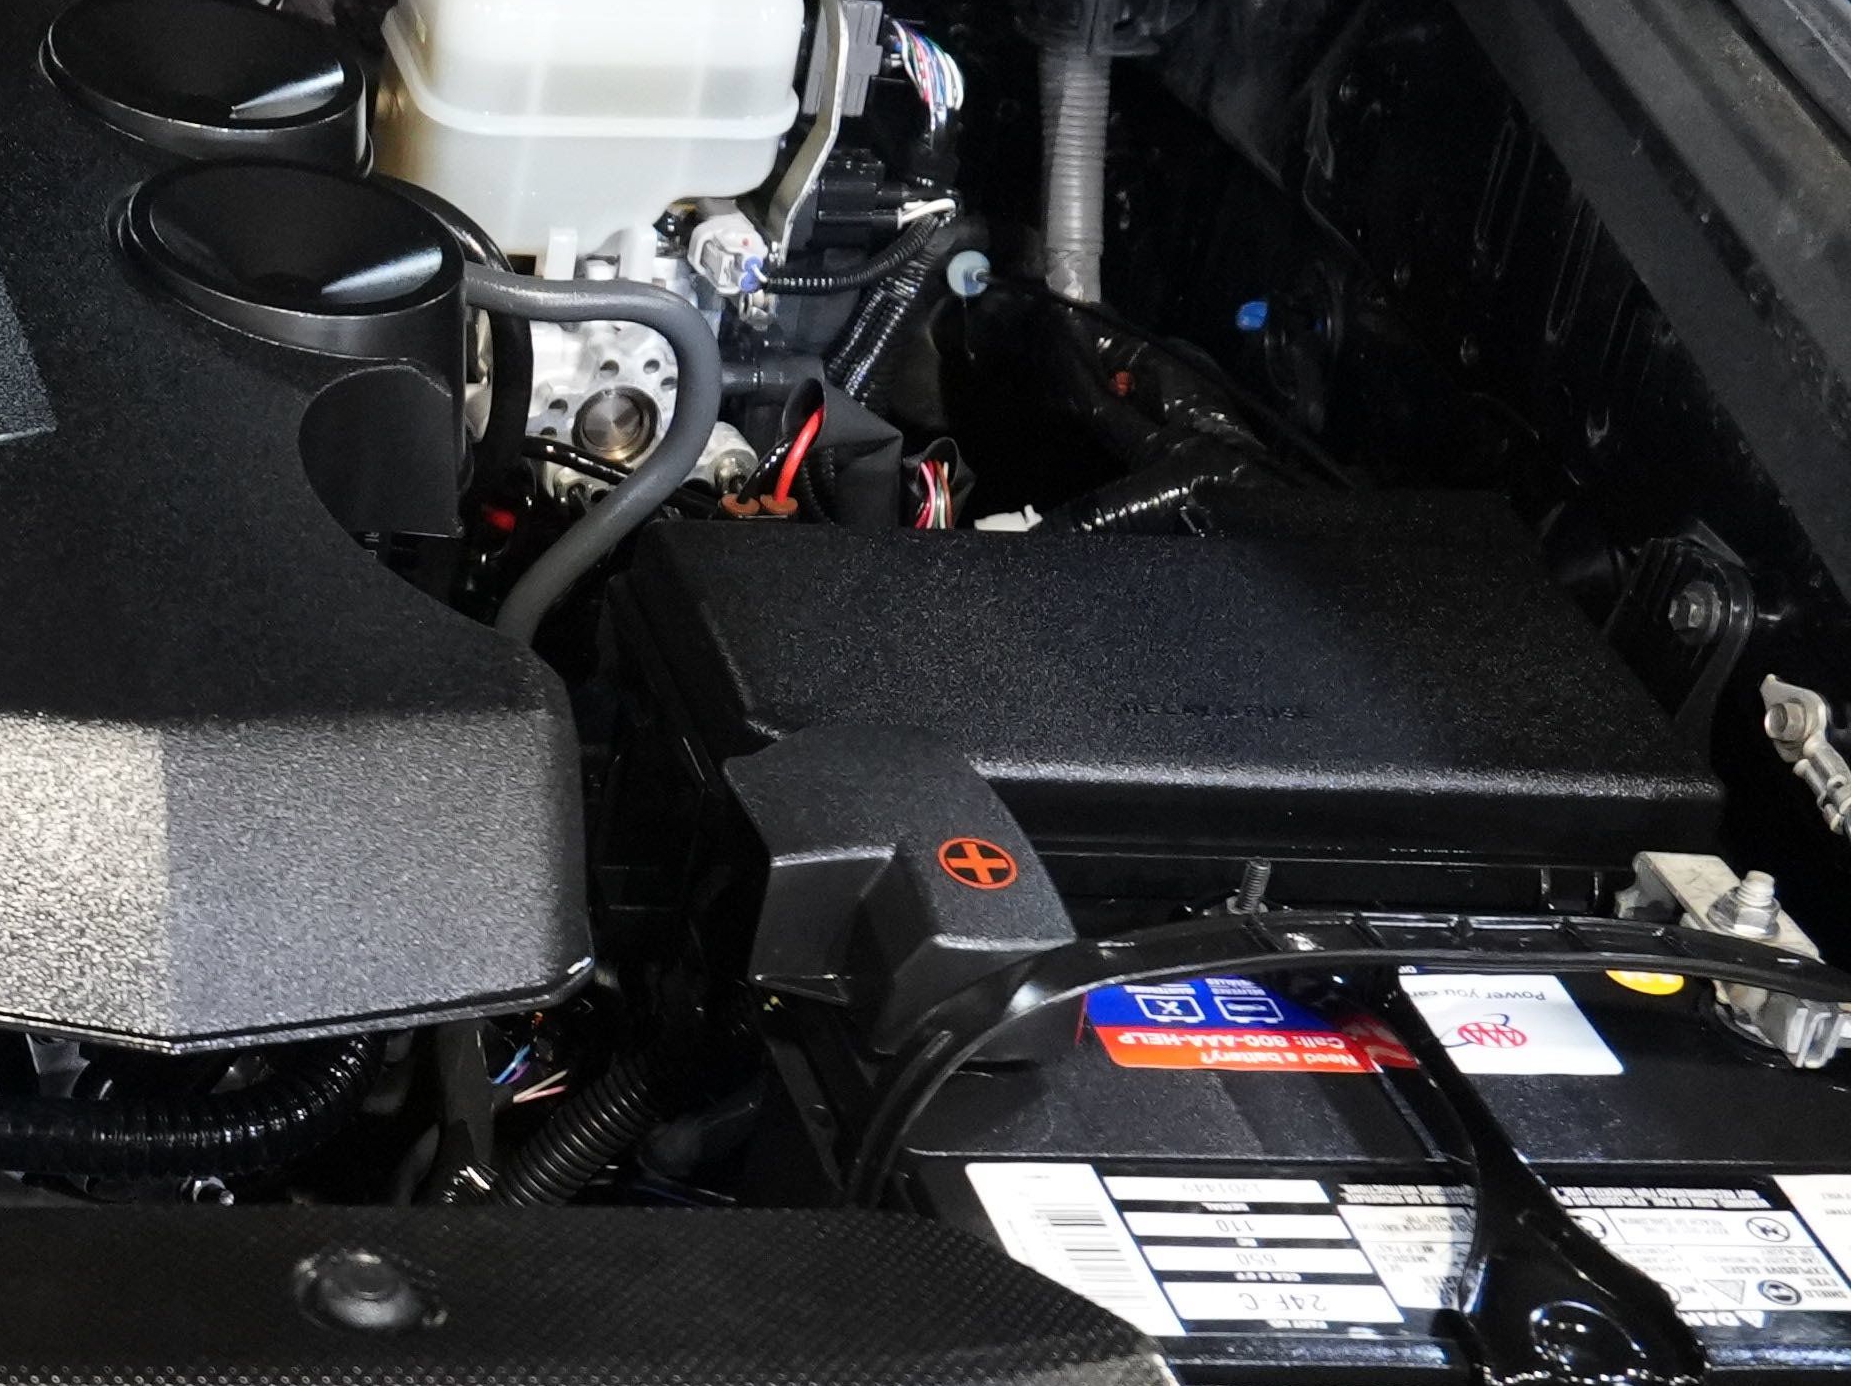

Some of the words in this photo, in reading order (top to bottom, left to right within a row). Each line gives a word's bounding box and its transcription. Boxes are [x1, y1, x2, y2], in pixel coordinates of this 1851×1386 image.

[1444, 988, 1479, 1000] you
[1485, 990, 1546, 1002] Power
[1117, 1031, 1288, 1048] 800-AAA-HELP
[1293, 1035, 1345, 1049] Call:
[1461, 1023, 1522, 1047] AAA
[1200, 1048, 1283, 1067] battery?
[1285, 1052, 1298, 1063] a
[1304, 1052, 1357, 1066] Need
[1215, 1219, 1256, 1233] 110
[1236, 1252, 1276, 1267] 650
[1237, 1292, 1328, 1313] 24F-C
